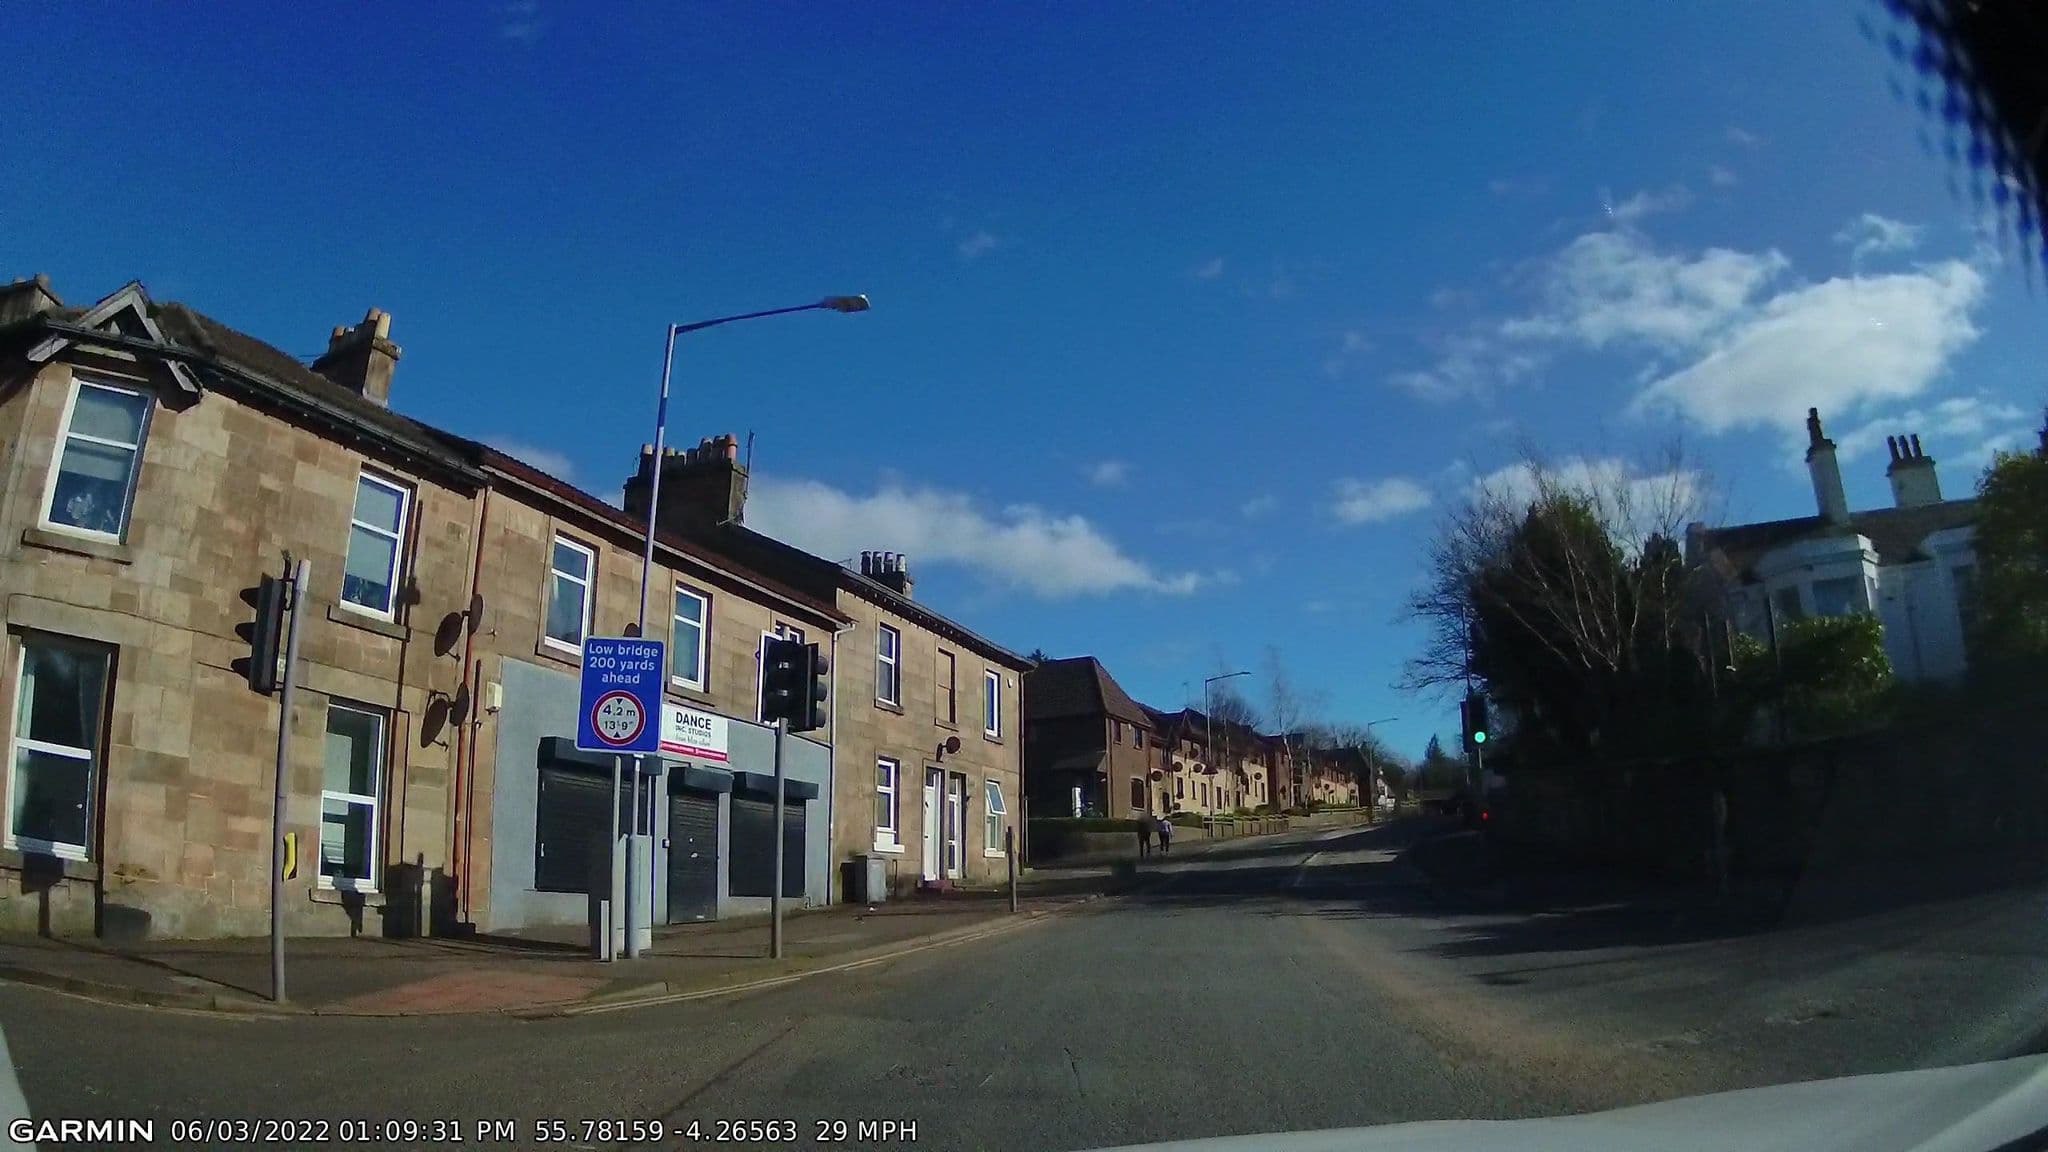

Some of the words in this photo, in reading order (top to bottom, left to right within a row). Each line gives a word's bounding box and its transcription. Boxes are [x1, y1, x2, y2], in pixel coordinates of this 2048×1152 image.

[589, 643, 613, 655] Low
[618, 644, 658, 658] bridge
[590, 657, 616, 669] 200
[620, 659, 655, 672] yards
[602, 672, 640, 684] ahead
[603, 704, 623, 717] 4.2
[626, 709, 636, 717] m
[676, 711, 712, 731] DANCE
